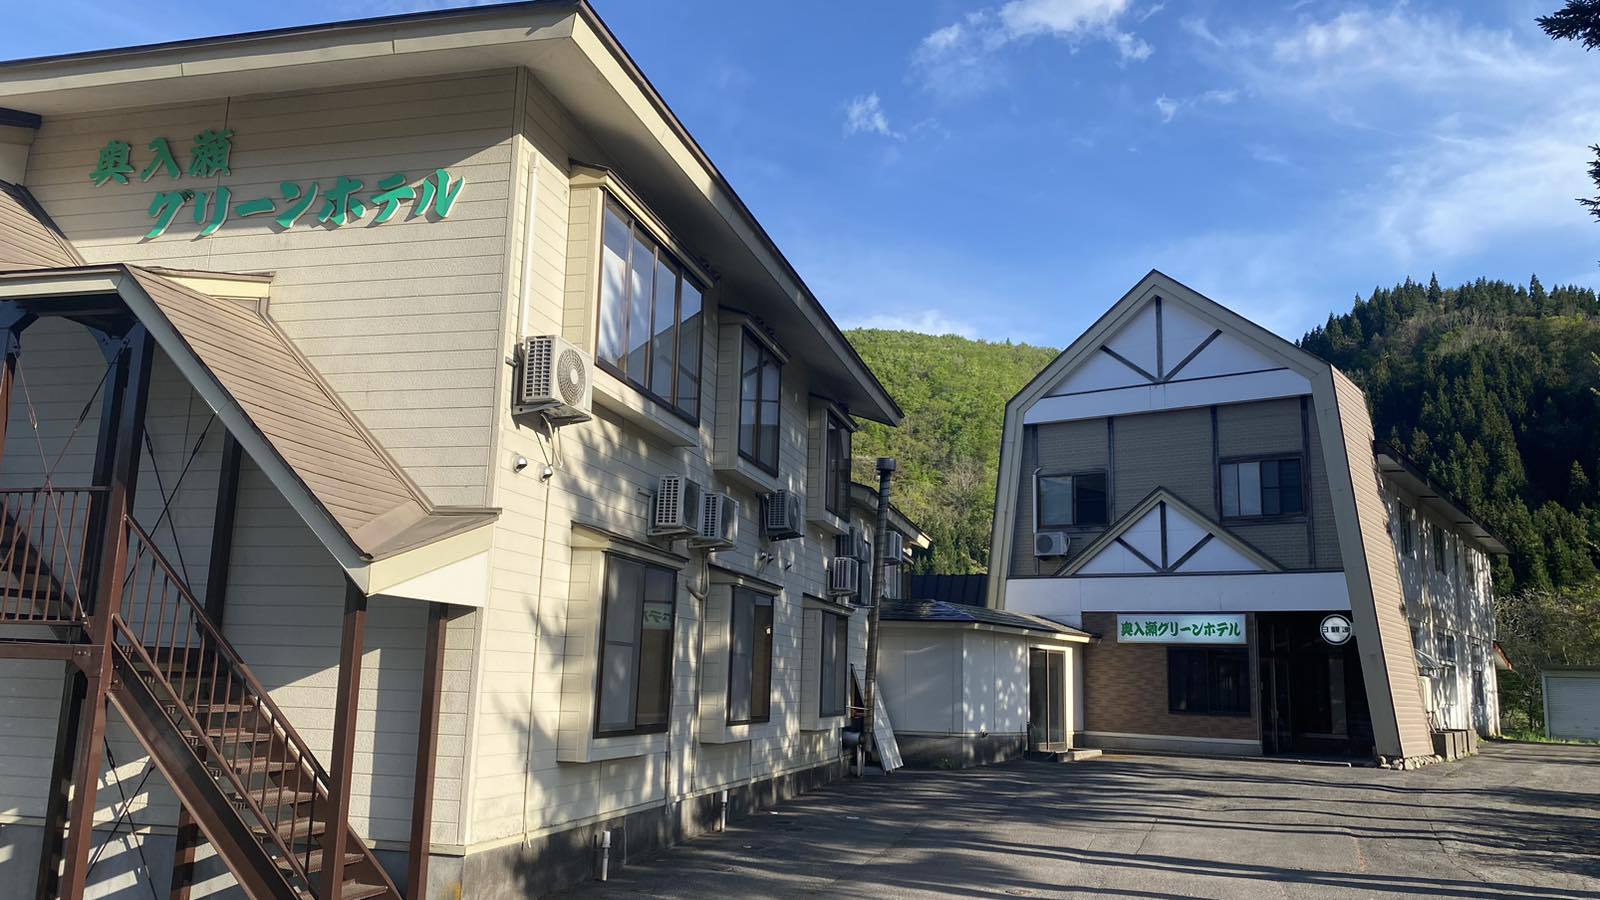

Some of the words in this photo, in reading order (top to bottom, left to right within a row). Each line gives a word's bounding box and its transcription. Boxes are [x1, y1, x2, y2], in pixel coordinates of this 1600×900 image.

[89, 128, 233, 187] 奥入瀬
[143, 168, 466, 240] グリーンホテル
[1121, 621, 1241, 637] 奥入瀬グリーンホテル
